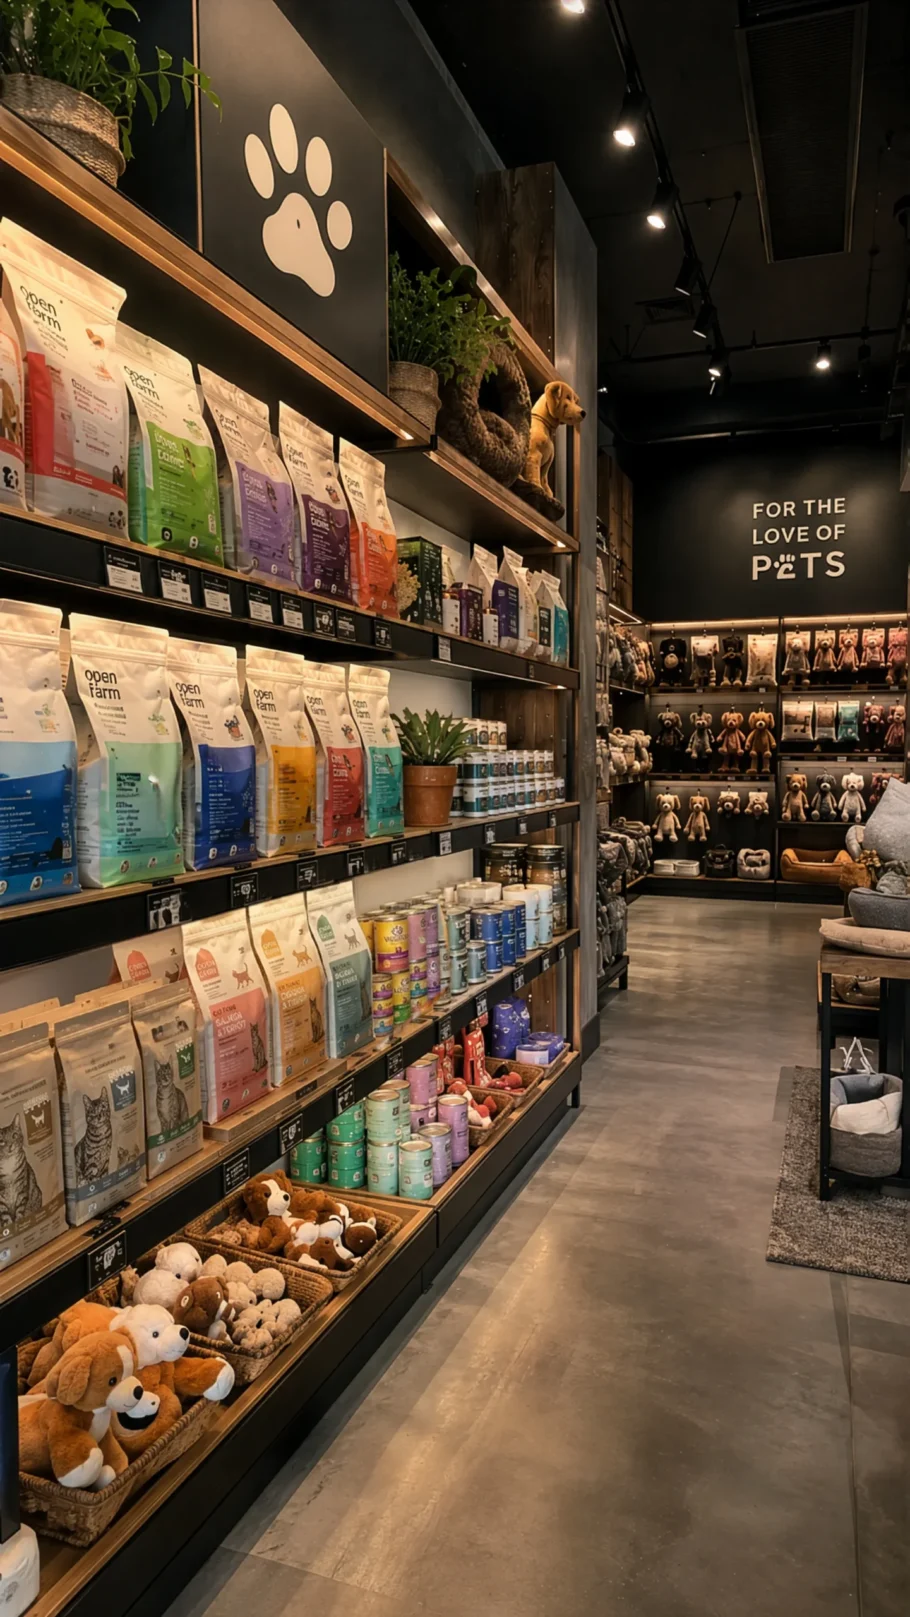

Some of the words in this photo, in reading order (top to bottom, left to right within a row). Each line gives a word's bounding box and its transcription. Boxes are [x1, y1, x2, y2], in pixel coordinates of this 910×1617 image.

[20, 285, 57, 317] open
[752, 501, 796, 520] FOR
[803, 497, 846, 515] THE
[752, 526, 810, 545] LOVE
[816, 524, 846, 541] OF
[752, 550, 846, 581] PETS
[85, 669, 117, 687] open
[89, 683, 121, 701] farm
[176, 682, 201, 698] open
[253, 688, 274, 703] open
[180, 694, 205, 709] farm
[256, 700, 277, 713] farm
